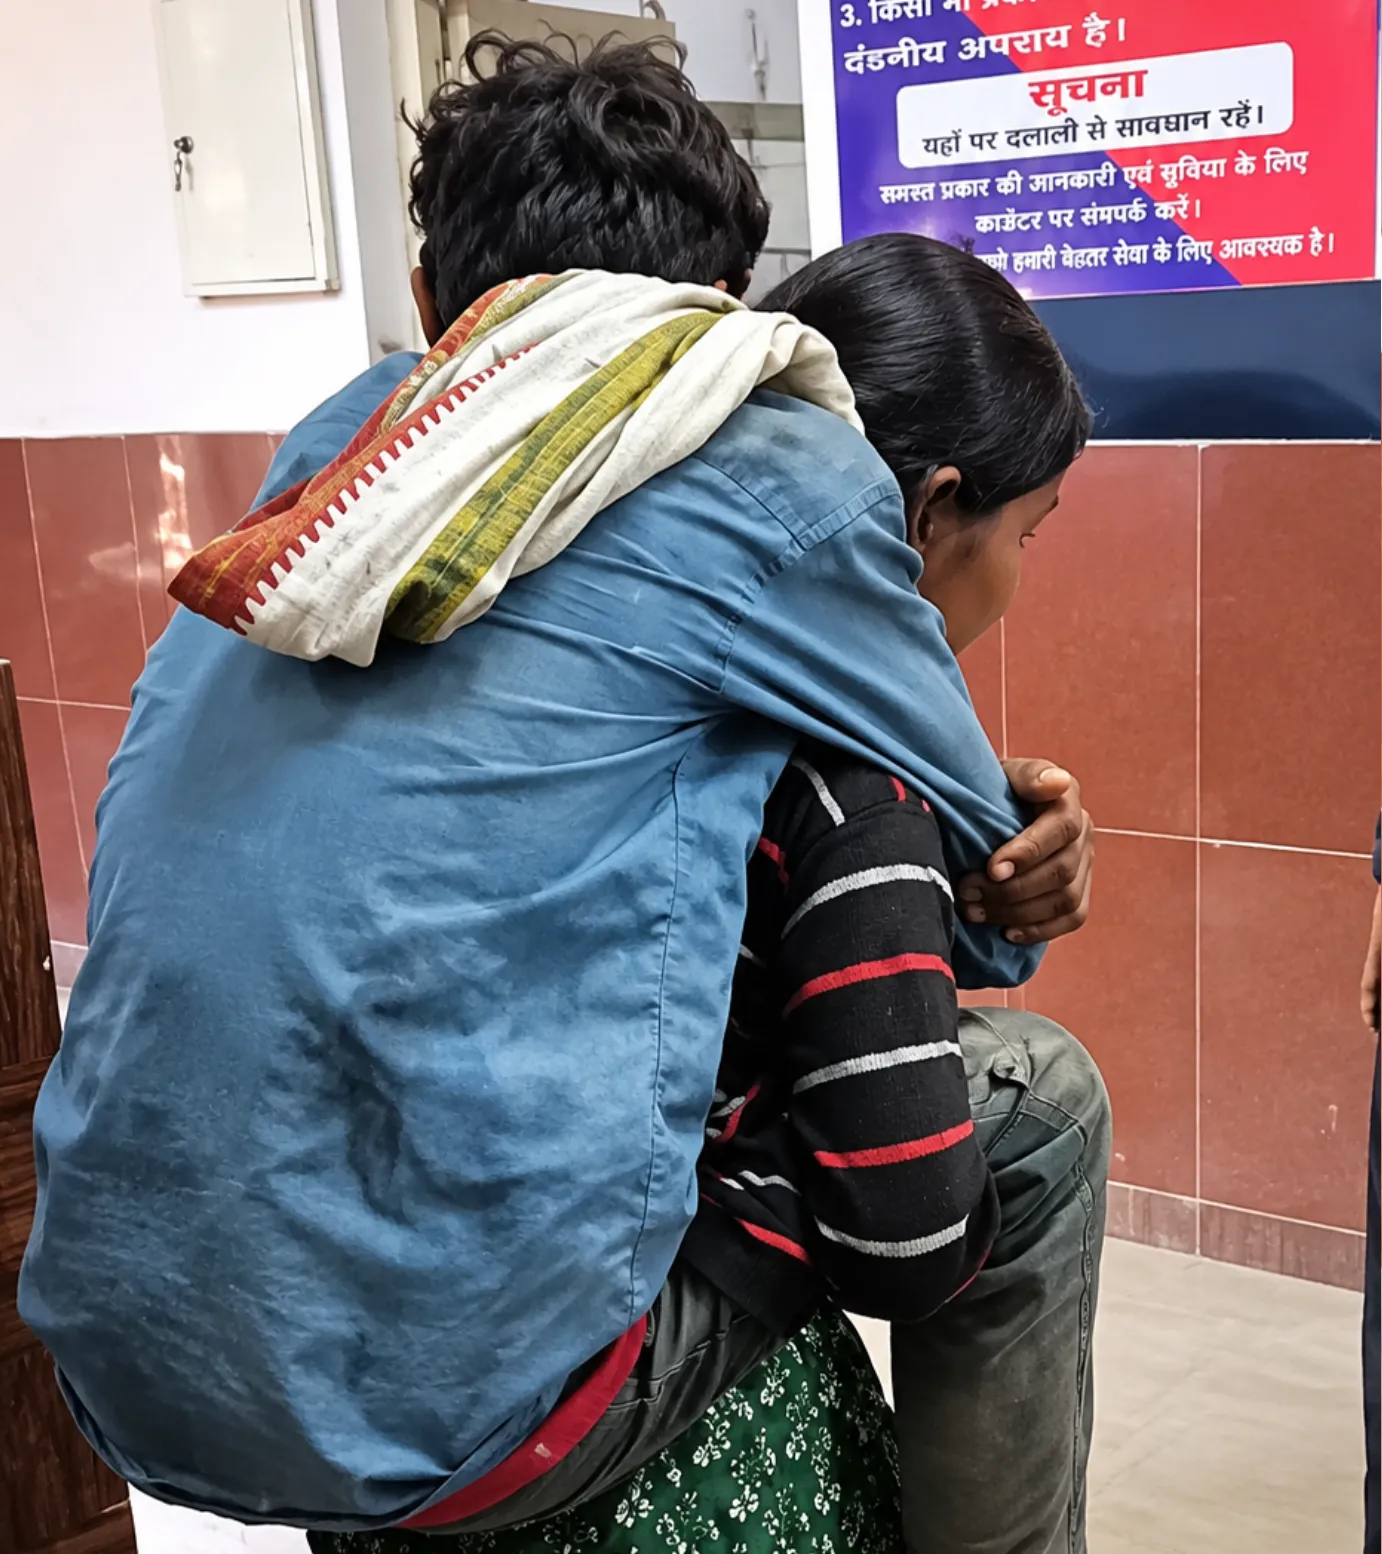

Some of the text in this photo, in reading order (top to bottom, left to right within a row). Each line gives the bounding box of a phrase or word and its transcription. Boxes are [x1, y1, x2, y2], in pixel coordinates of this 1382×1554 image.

[840, 3, 863, 28] 3.
[844, 37, 947, 75] दंडनीय
[1028, 69, 1148, 117] सूचना
[968, 131, 998, 151] पर
[1004, 117, 1079, 149] दलाली
[1086, 114, 1107, 141] से
[879, 182, 935, 204] समस्त
[940, 178, 991, 200] प्रकार
[996, 169, 1023, 196] की
[1122, 159, 1154, 189] एवं
[1234, 150, 1257, 176] के
[1264, 147, 1309, 175] लिए
[1047, 209, 1075, 228] पर
[1112, 238, 1149, 267] सेवा
[1153, 236, 1173, 264] के
[1176, 235, 1214, 264] लिए
